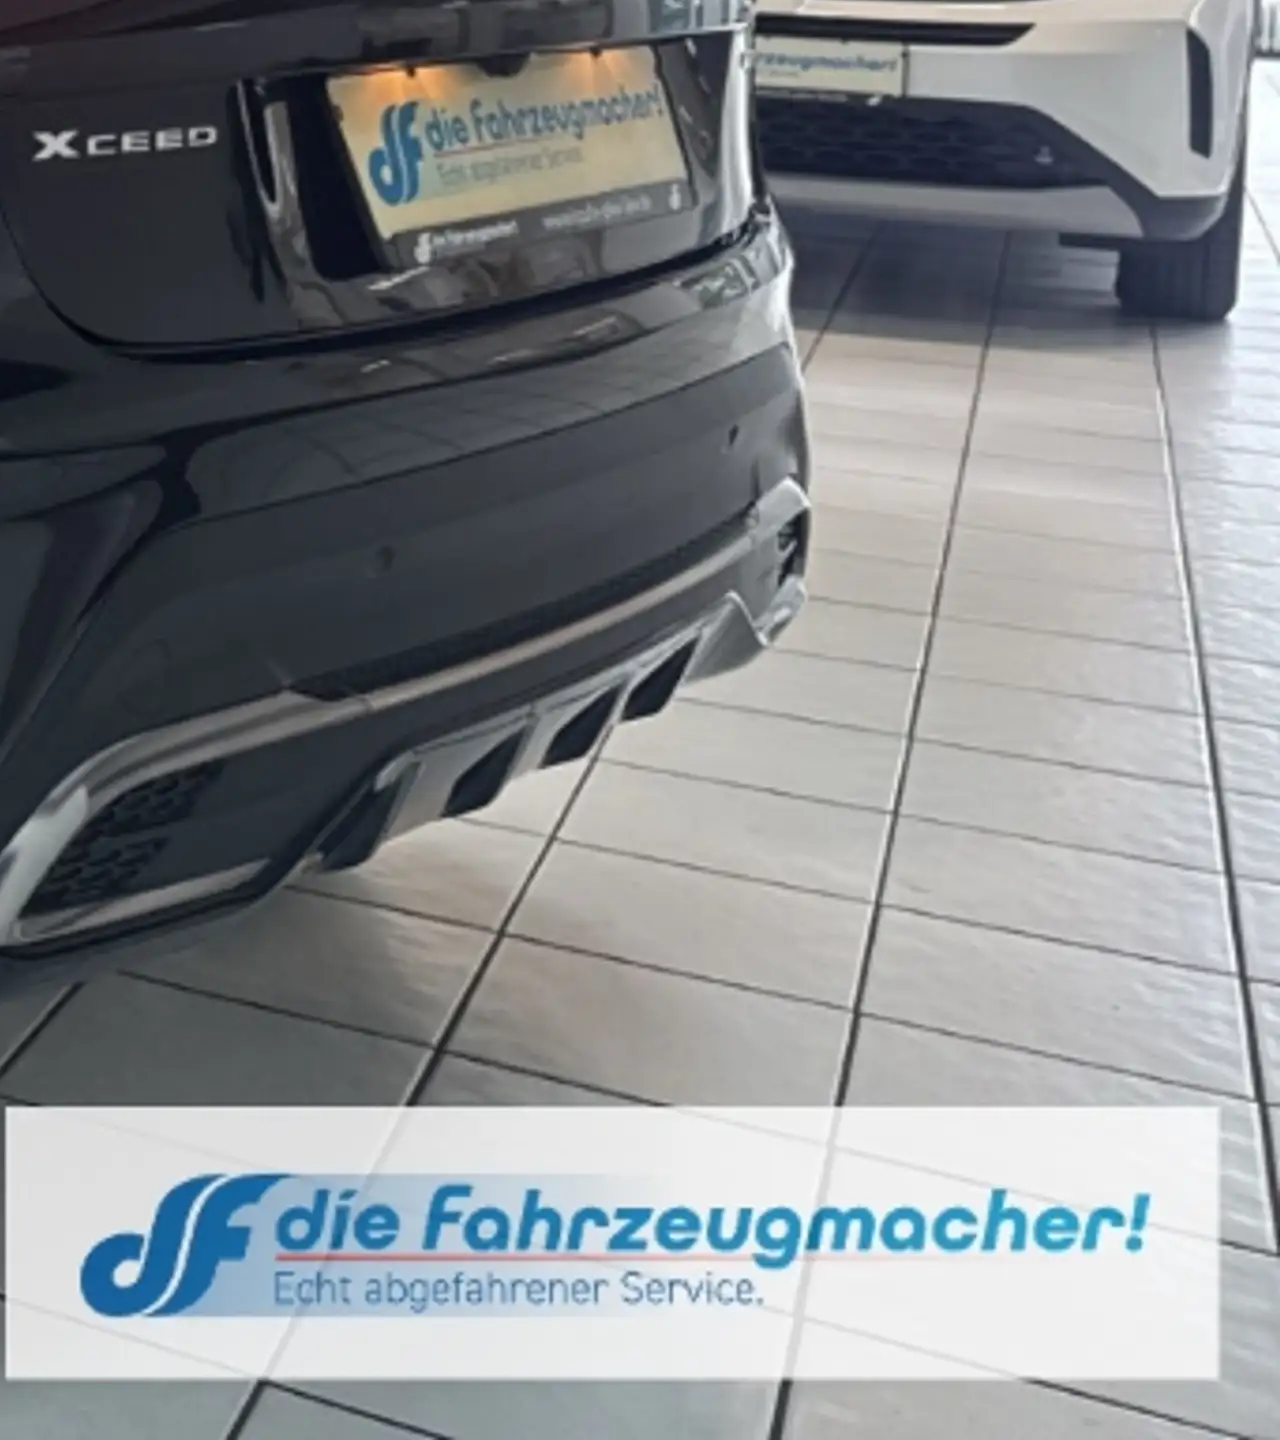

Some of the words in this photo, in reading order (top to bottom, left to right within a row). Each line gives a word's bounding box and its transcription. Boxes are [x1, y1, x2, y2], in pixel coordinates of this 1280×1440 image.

[424, 106, 470, 151] die
[470, 79, 664, 141] Fahrzeugmacher!
[32, 125, 219, 162] XCEED
